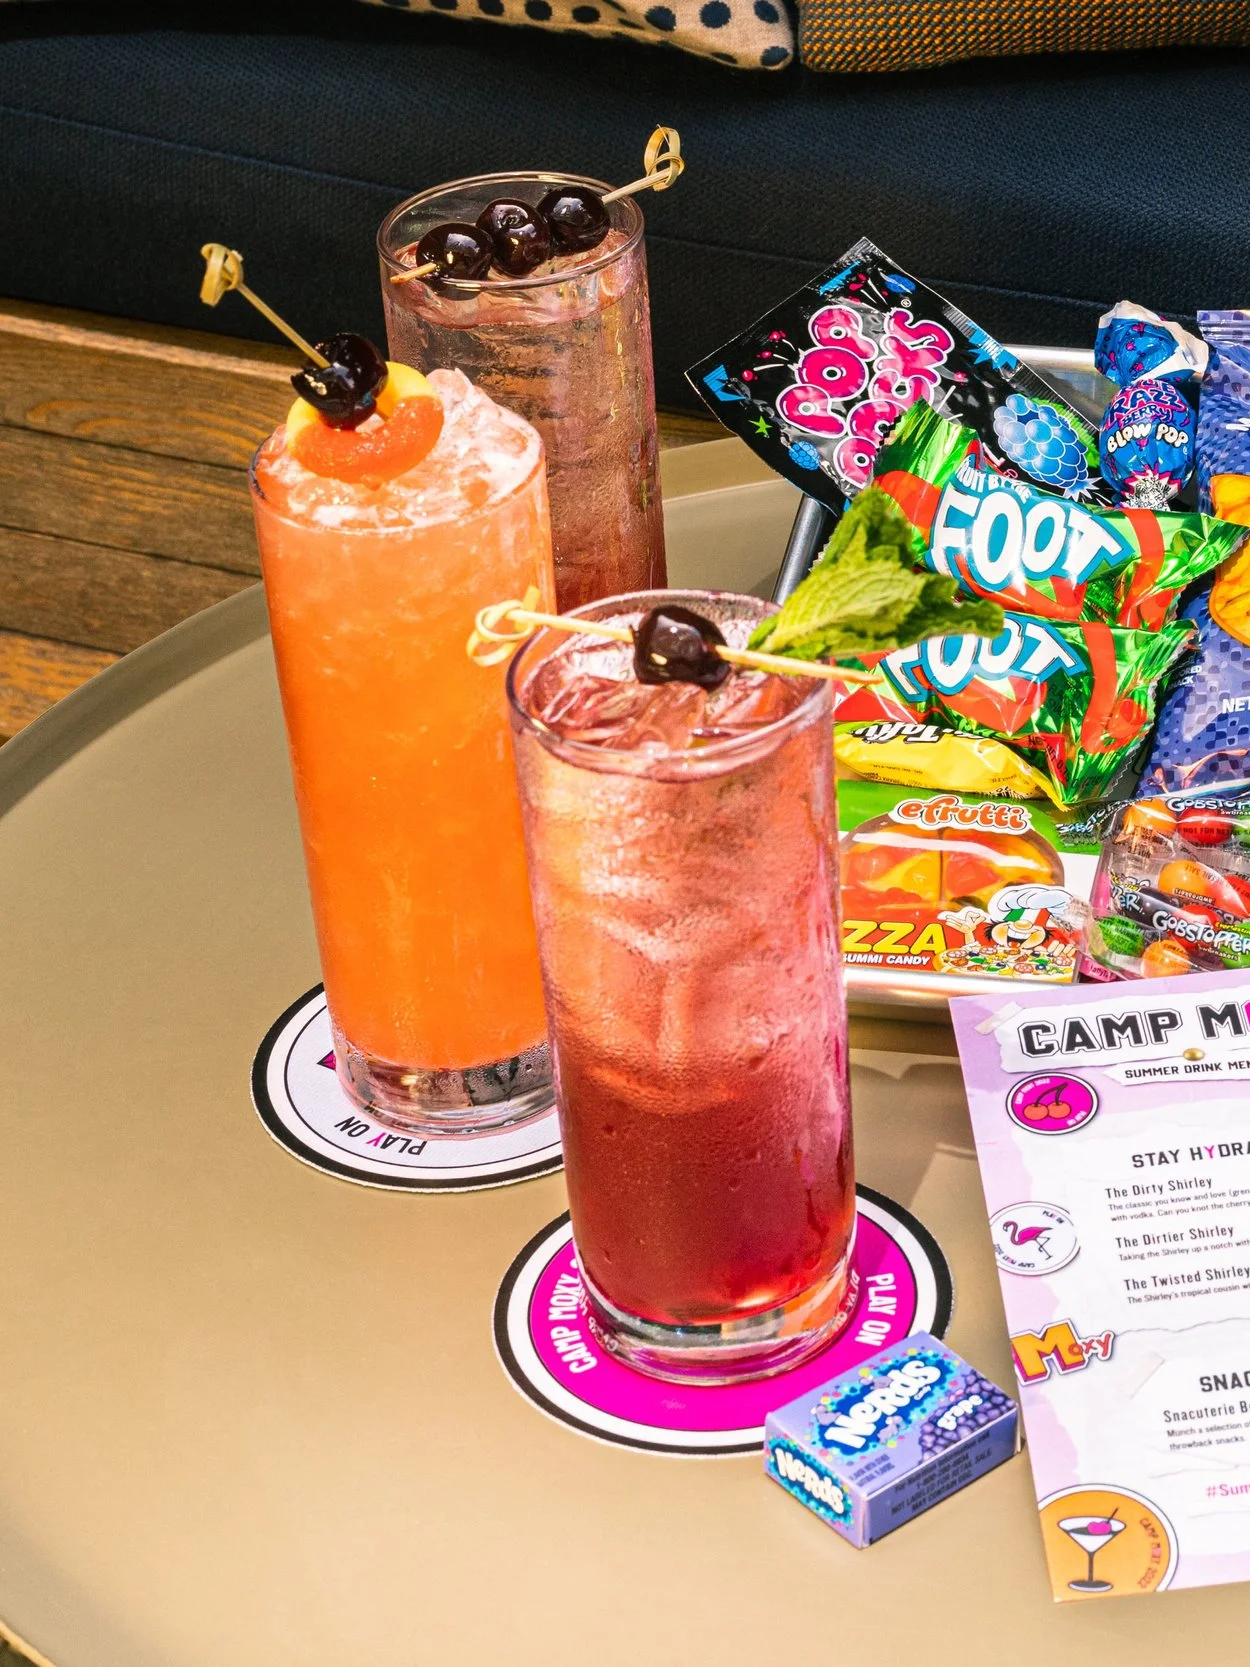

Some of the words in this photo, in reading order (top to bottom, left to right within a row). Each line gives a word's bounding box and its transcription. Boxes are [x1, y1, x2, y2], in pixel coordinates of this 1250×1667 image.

[776, 305, 878, 438] POP
[1109, 389, 1185, 424] RAZZ
[1122, 405, 1174, 426] BERRY
[1106, 423, 1152, 453] BLOW
[1155, 423, 1189, 447] POP
[932, 482, 1122, 586] FOOT
[898, 795, 1029, 830] efrutti
[842, 920, 947, 956] ZZA
[886, 954, 931, 966] CANDY
[1017, 1008, 1183, 1058] CAMP
[1125, 1066, 1179, 1079] SUMMER
[1184, 1062, 1222, 1075] DRINK
[334, 1116, 371, 1138] ON
[366, 1131, 428, 1156] PLAY
[1132, 1149, 1181, 1168] STAY
[1105, 1187, 1129, 1199] The
[1132, 1183, 1164, 1197] Dirty
[1168, 1177, 1213, 1191] Shirley
[1108, 1203, 1124, 1211] The
[1125, 1201, 1152, 1210] classic
[1155, 1199, 1169, 1208] you
[1171, 1195, 1191, 1204] know
[1194, 1193, 1208, 1201] and
[1210, 1190, 1227, 1198] love
[1111, 1214, 1128, 1222] with
[1129, 1211, 1156, 1220] vodka.
[1176, 1207, 1189, 1215] you
[1191, 1204, 1209, 1212] knot
[1211, 1202, 1224, 1210] the
[1226, 1199, 1250, 1208] cherry
[1115, 1237, 1138, 1248] The
[1143, 1232, 1185, 1246] Dirtier
[1189, 1225, 1234, 1240] Shirley
[1118, 1252, 1145, 1262] Taking
[1162, 1246, 1189, 1256] Shirley
[1210, 1240, 1234, 1250] notch
[1124, 1279, 1147, 1291] The
[1151, 1272, 1201, 1288] Twisted
[1205, 1266, 1250, 1281] Shirley
[548, 1272, 581, 1322] MOXY
[864, 1272, 896, 1315] PLAY
[1127, 1296, 1143, 1304] The
[1144, 1292, 1179, 1302] Shirley's
[1181, 1287, 1211, 1298] tropical
[1213, 1284, 1240, 1293] cousin
[855, 1319, 892, 1347] ON
[554, 1326, 598, 1374] CAMP
[1010, 1321, 1112, 1382] Moxy
[824, 1360, 941, 1449] Nerds
[1163, 1404, 1235, 1423] Snacuterie
[1167, 1426, 1196, 1438] Munch
[1205, 1421, 1242, 1433] selection
[1169, 1439, 1213, 1450] throwback
[1215, 1435, 1246, 1445] snacks.
[774, 1447, 844, 1515] Nerds
